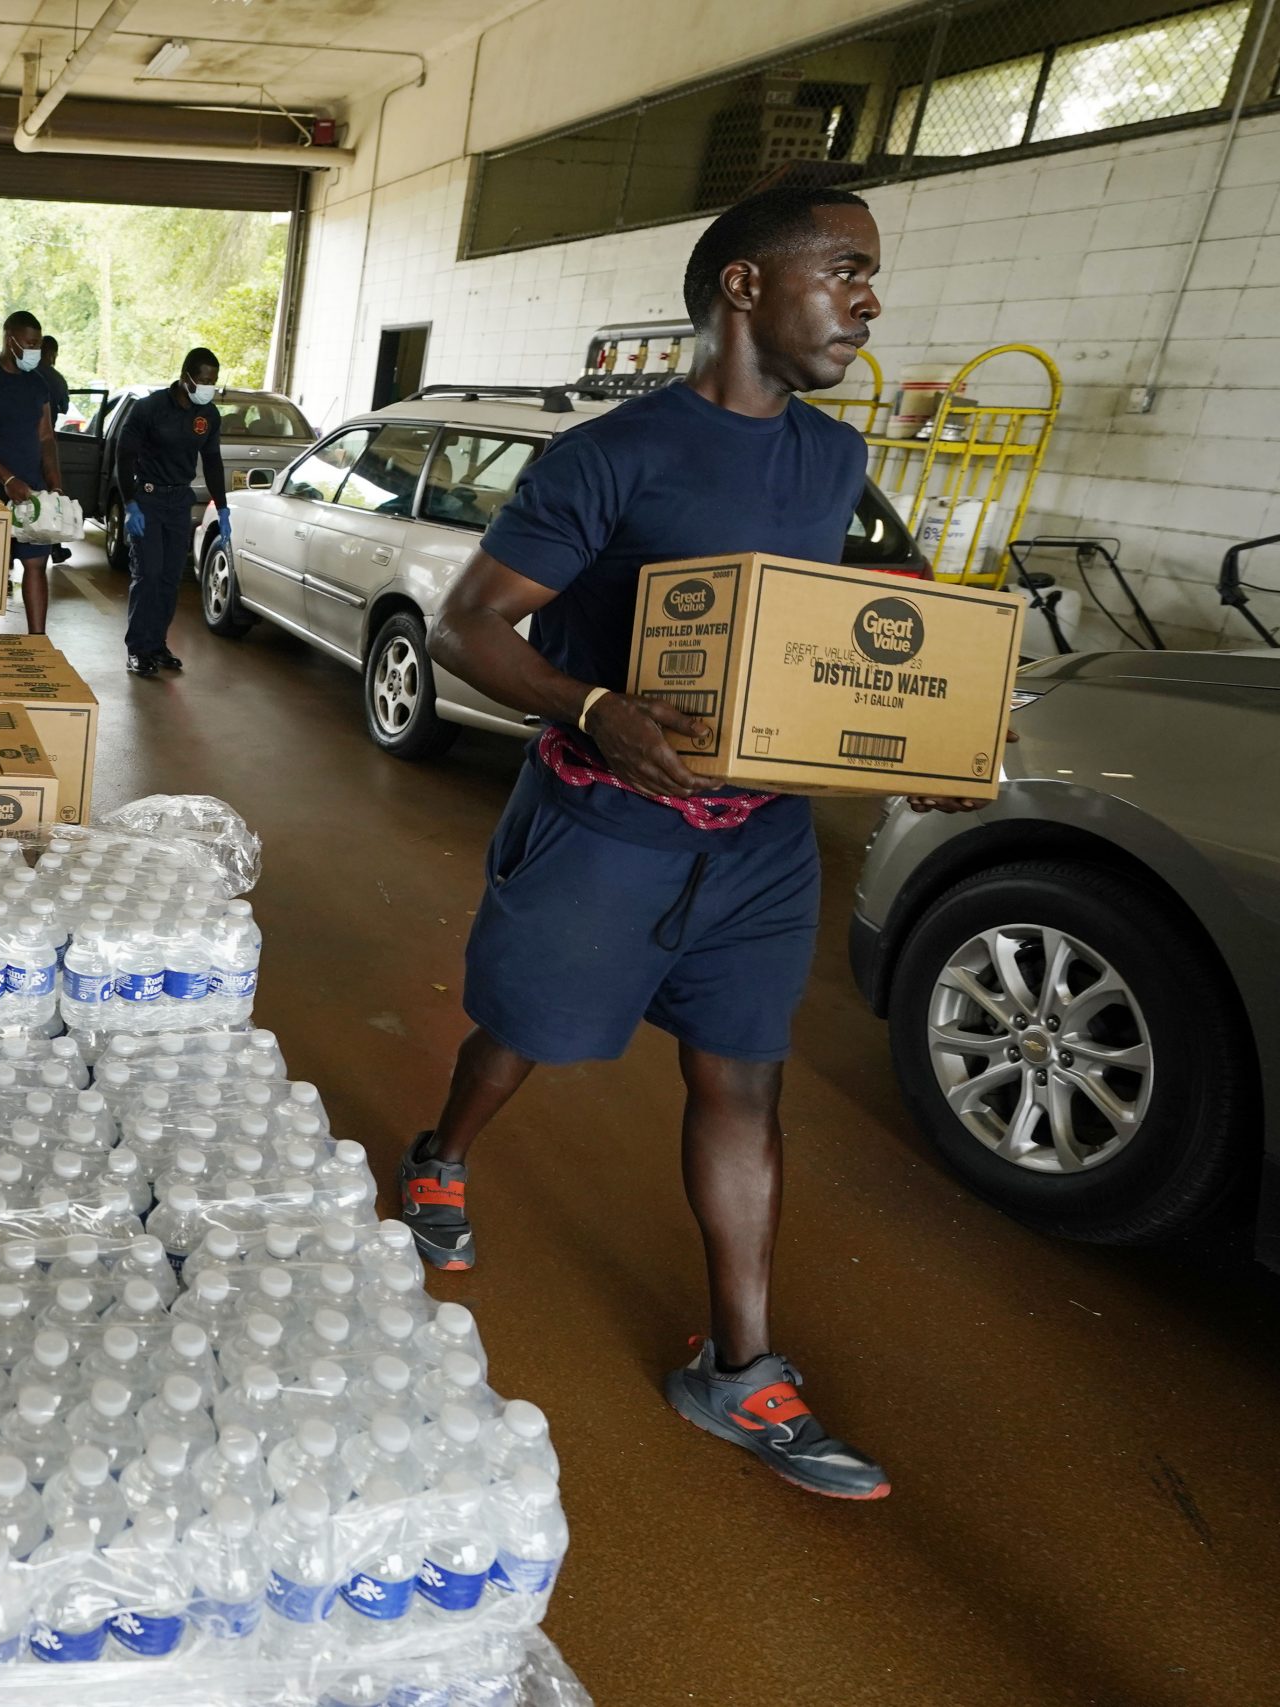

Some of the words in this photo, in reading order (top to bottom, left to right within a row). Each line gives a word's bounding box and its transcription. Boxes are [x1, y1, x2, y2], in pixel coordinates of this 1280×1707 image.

[670, 589, 706, 604] Great
[678, 602, 705, 612] Value
[646, 625, 692, 638] DISTILLED
[695, 623, 728, 636] WATER
[862, 610, 914, 639] Great
[668, 640, 677, 648] 3-1
[872, 633, 911, 653] Value
[786, 642, 819, 656] GREAT
[825, 646, 856, 661] VALUE
[784, 654, 804, 666] EXP
[813, 660, 894, 692] DISTILLED
[898, 672, 948, 700] WATER
[854, 692, 868, 705] 3-1
[870, 693, 904, 709] GALLON
[752, 726, 764, 734] Case
